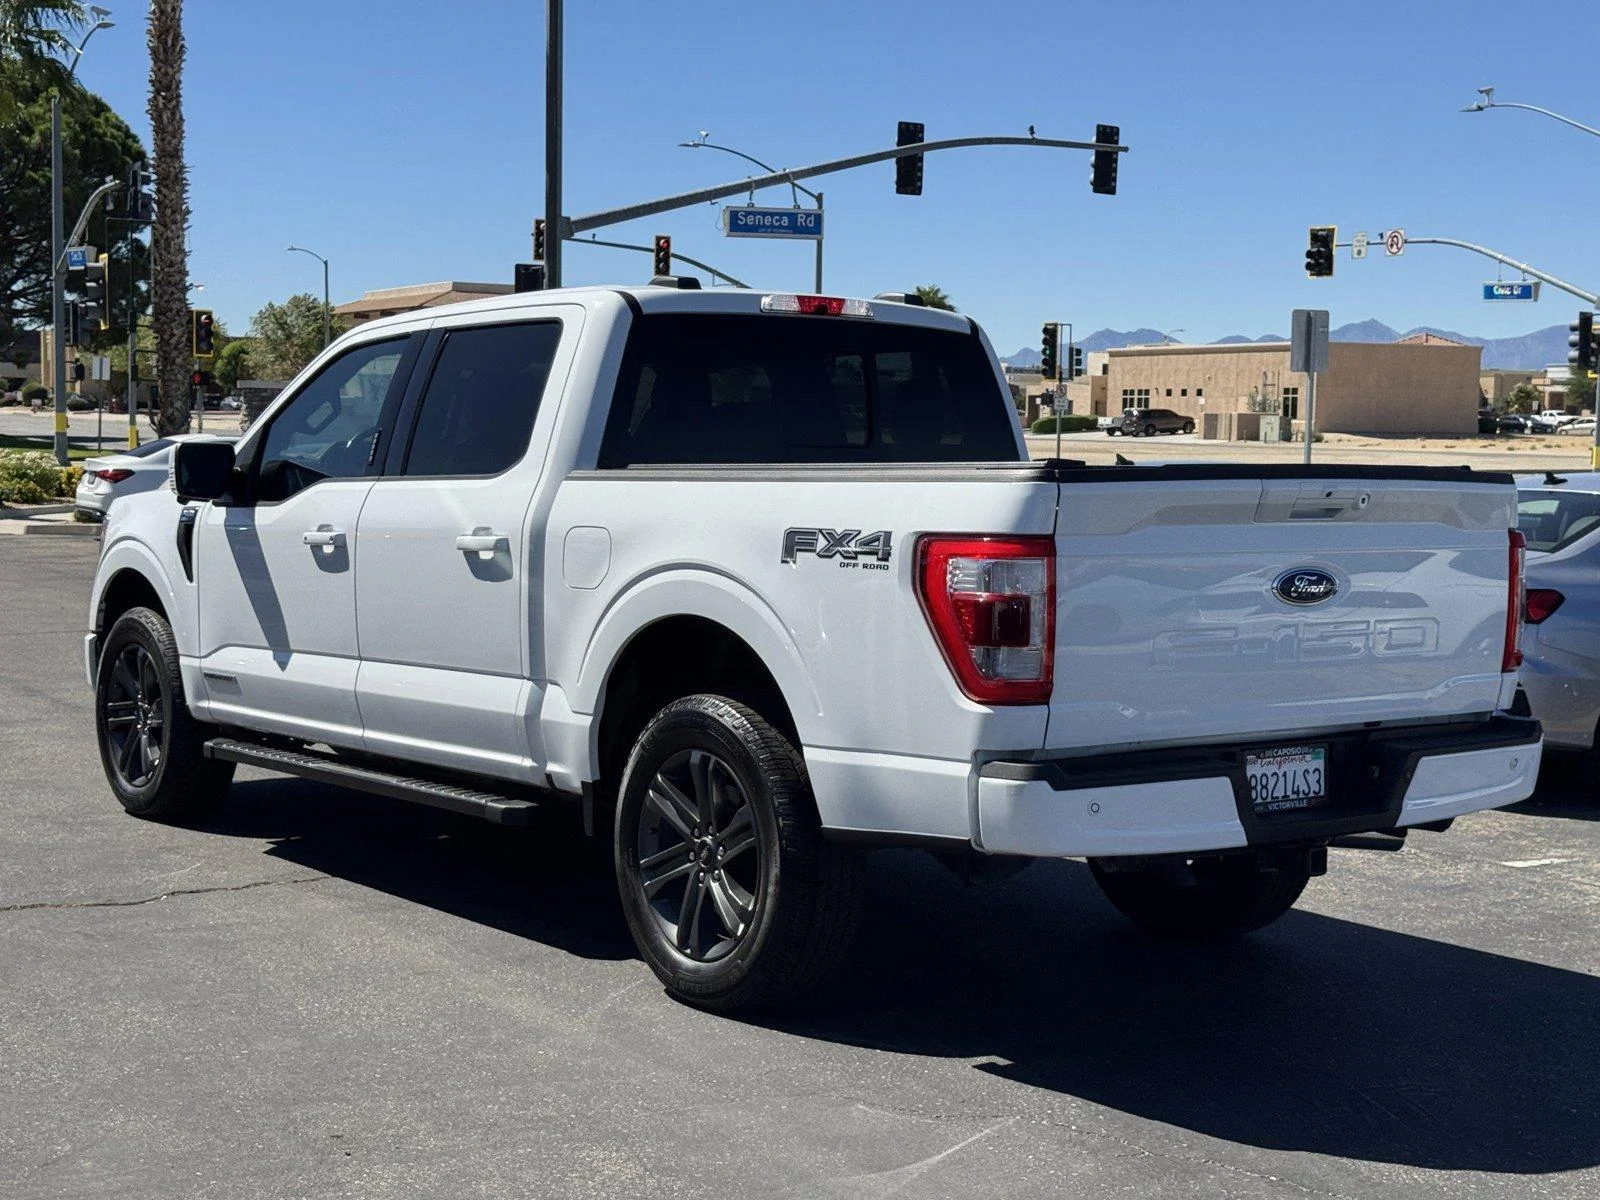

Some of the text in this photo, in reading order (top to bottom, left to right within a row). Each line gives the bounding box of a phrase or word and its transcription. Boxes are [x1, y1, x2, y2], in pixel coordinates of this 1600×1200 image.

[737, 211, 815, 227] Seneca Rd
[780, 526, 893, 564] FX4
[839, 561, 890, 571] OFF ROAD
[1290, 574, 1327, 597] Ford
